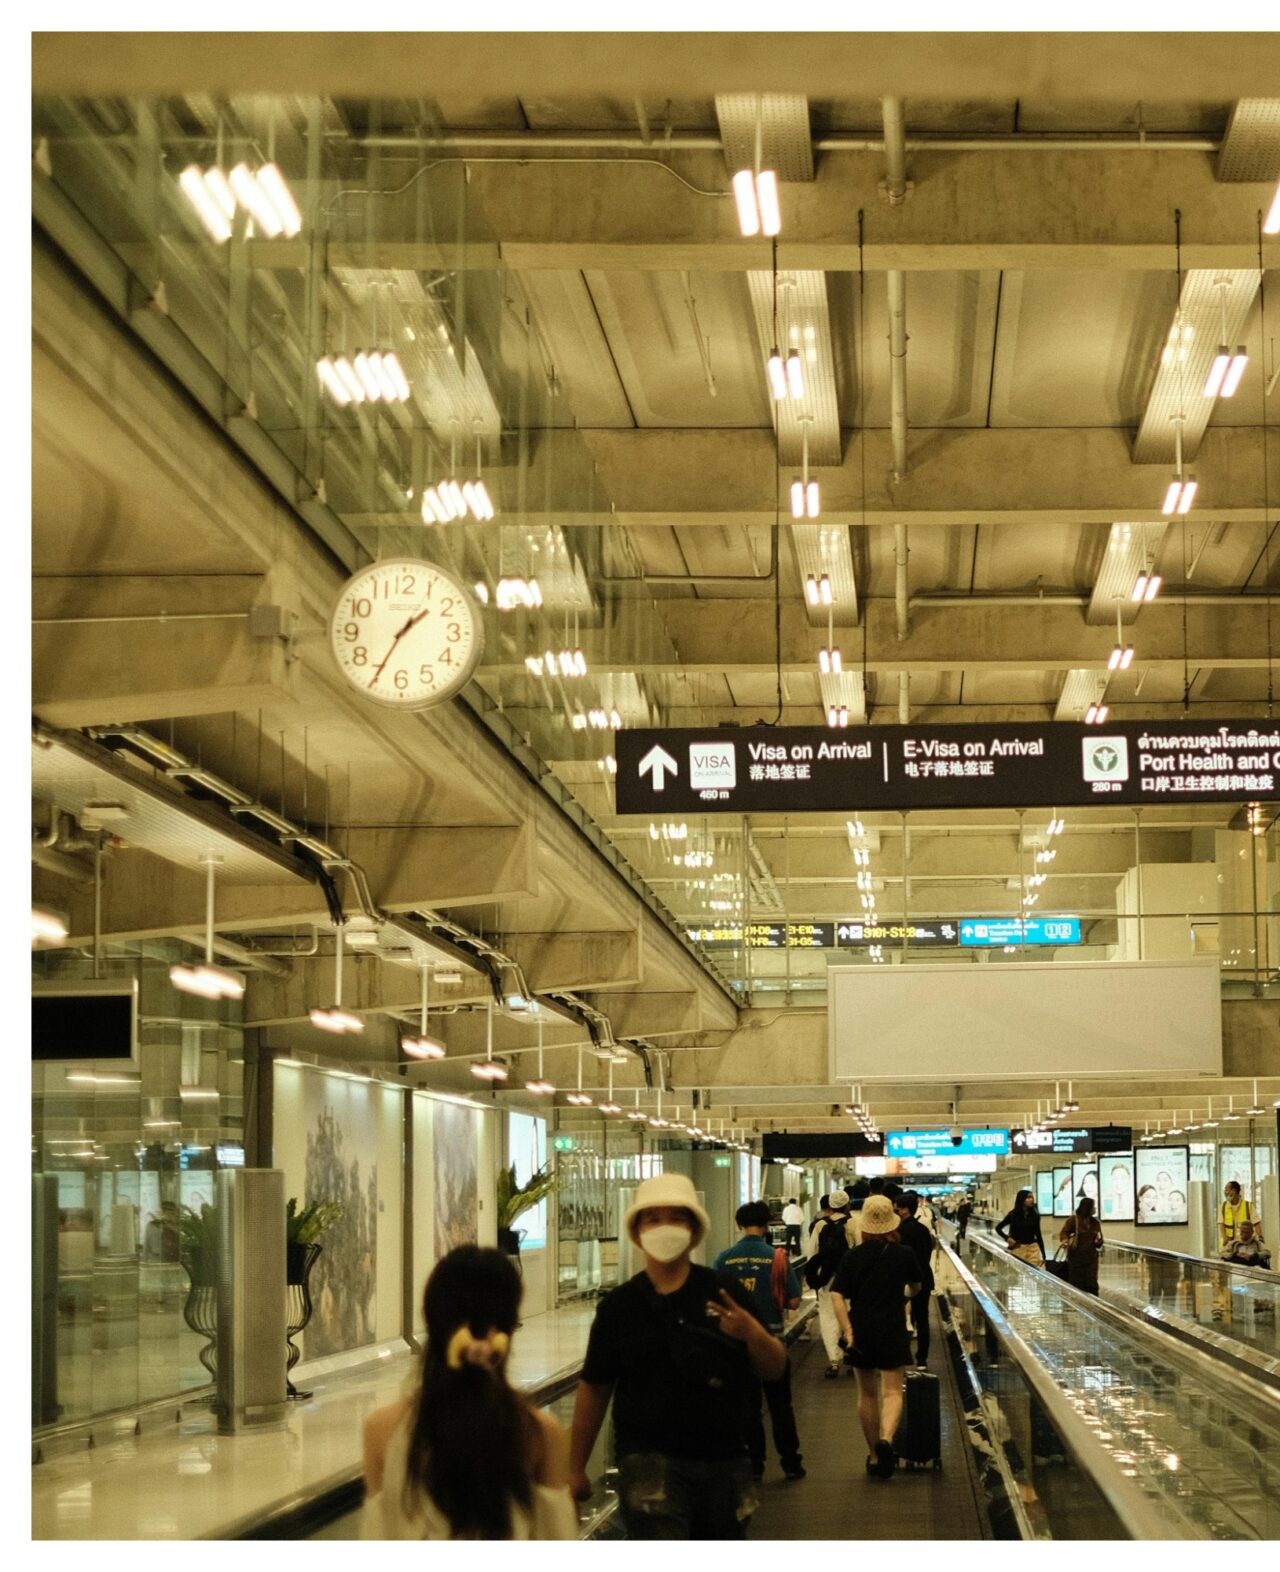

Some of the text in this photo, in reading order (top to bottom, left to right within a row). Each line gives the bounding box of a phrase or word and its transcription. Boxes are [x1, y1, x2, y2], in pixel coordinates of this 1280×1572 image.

[374, 580, 388, 599] 11
[396, 575, 416, 594] 12
[427, 580, 432, 599] 1
[352, 598, 371, 618] 10
[440, 597, 454, 617] 2
[344, 622, 359, 642] 9
[447, 622, 460, 642] 3
[353, 646, 367, 666] 8
[438, 647, 453, 666] 4
[394, 670, 408, 689] 6
[419, 664, 434, 684] 5
[748, 741, 872, 760] Visa on Arrival
[903, 738, 1044, 758] E-Visa on Arrival
[694, 755, 731, 769] VISA
[904, 760, 995, 777] 电子落地签证
[1140, 754, 1175, 771] Port
[1179, 753, 1233, 770] Health
[1237, 752, 1269, 769] and
[749, 763, 811, 780] 落地签证
[1112, 783, 1122, 791] m
[1141, 774, 1274, 792] 口岸卫生控制和检疫
[719, 791, 730, 799] m
